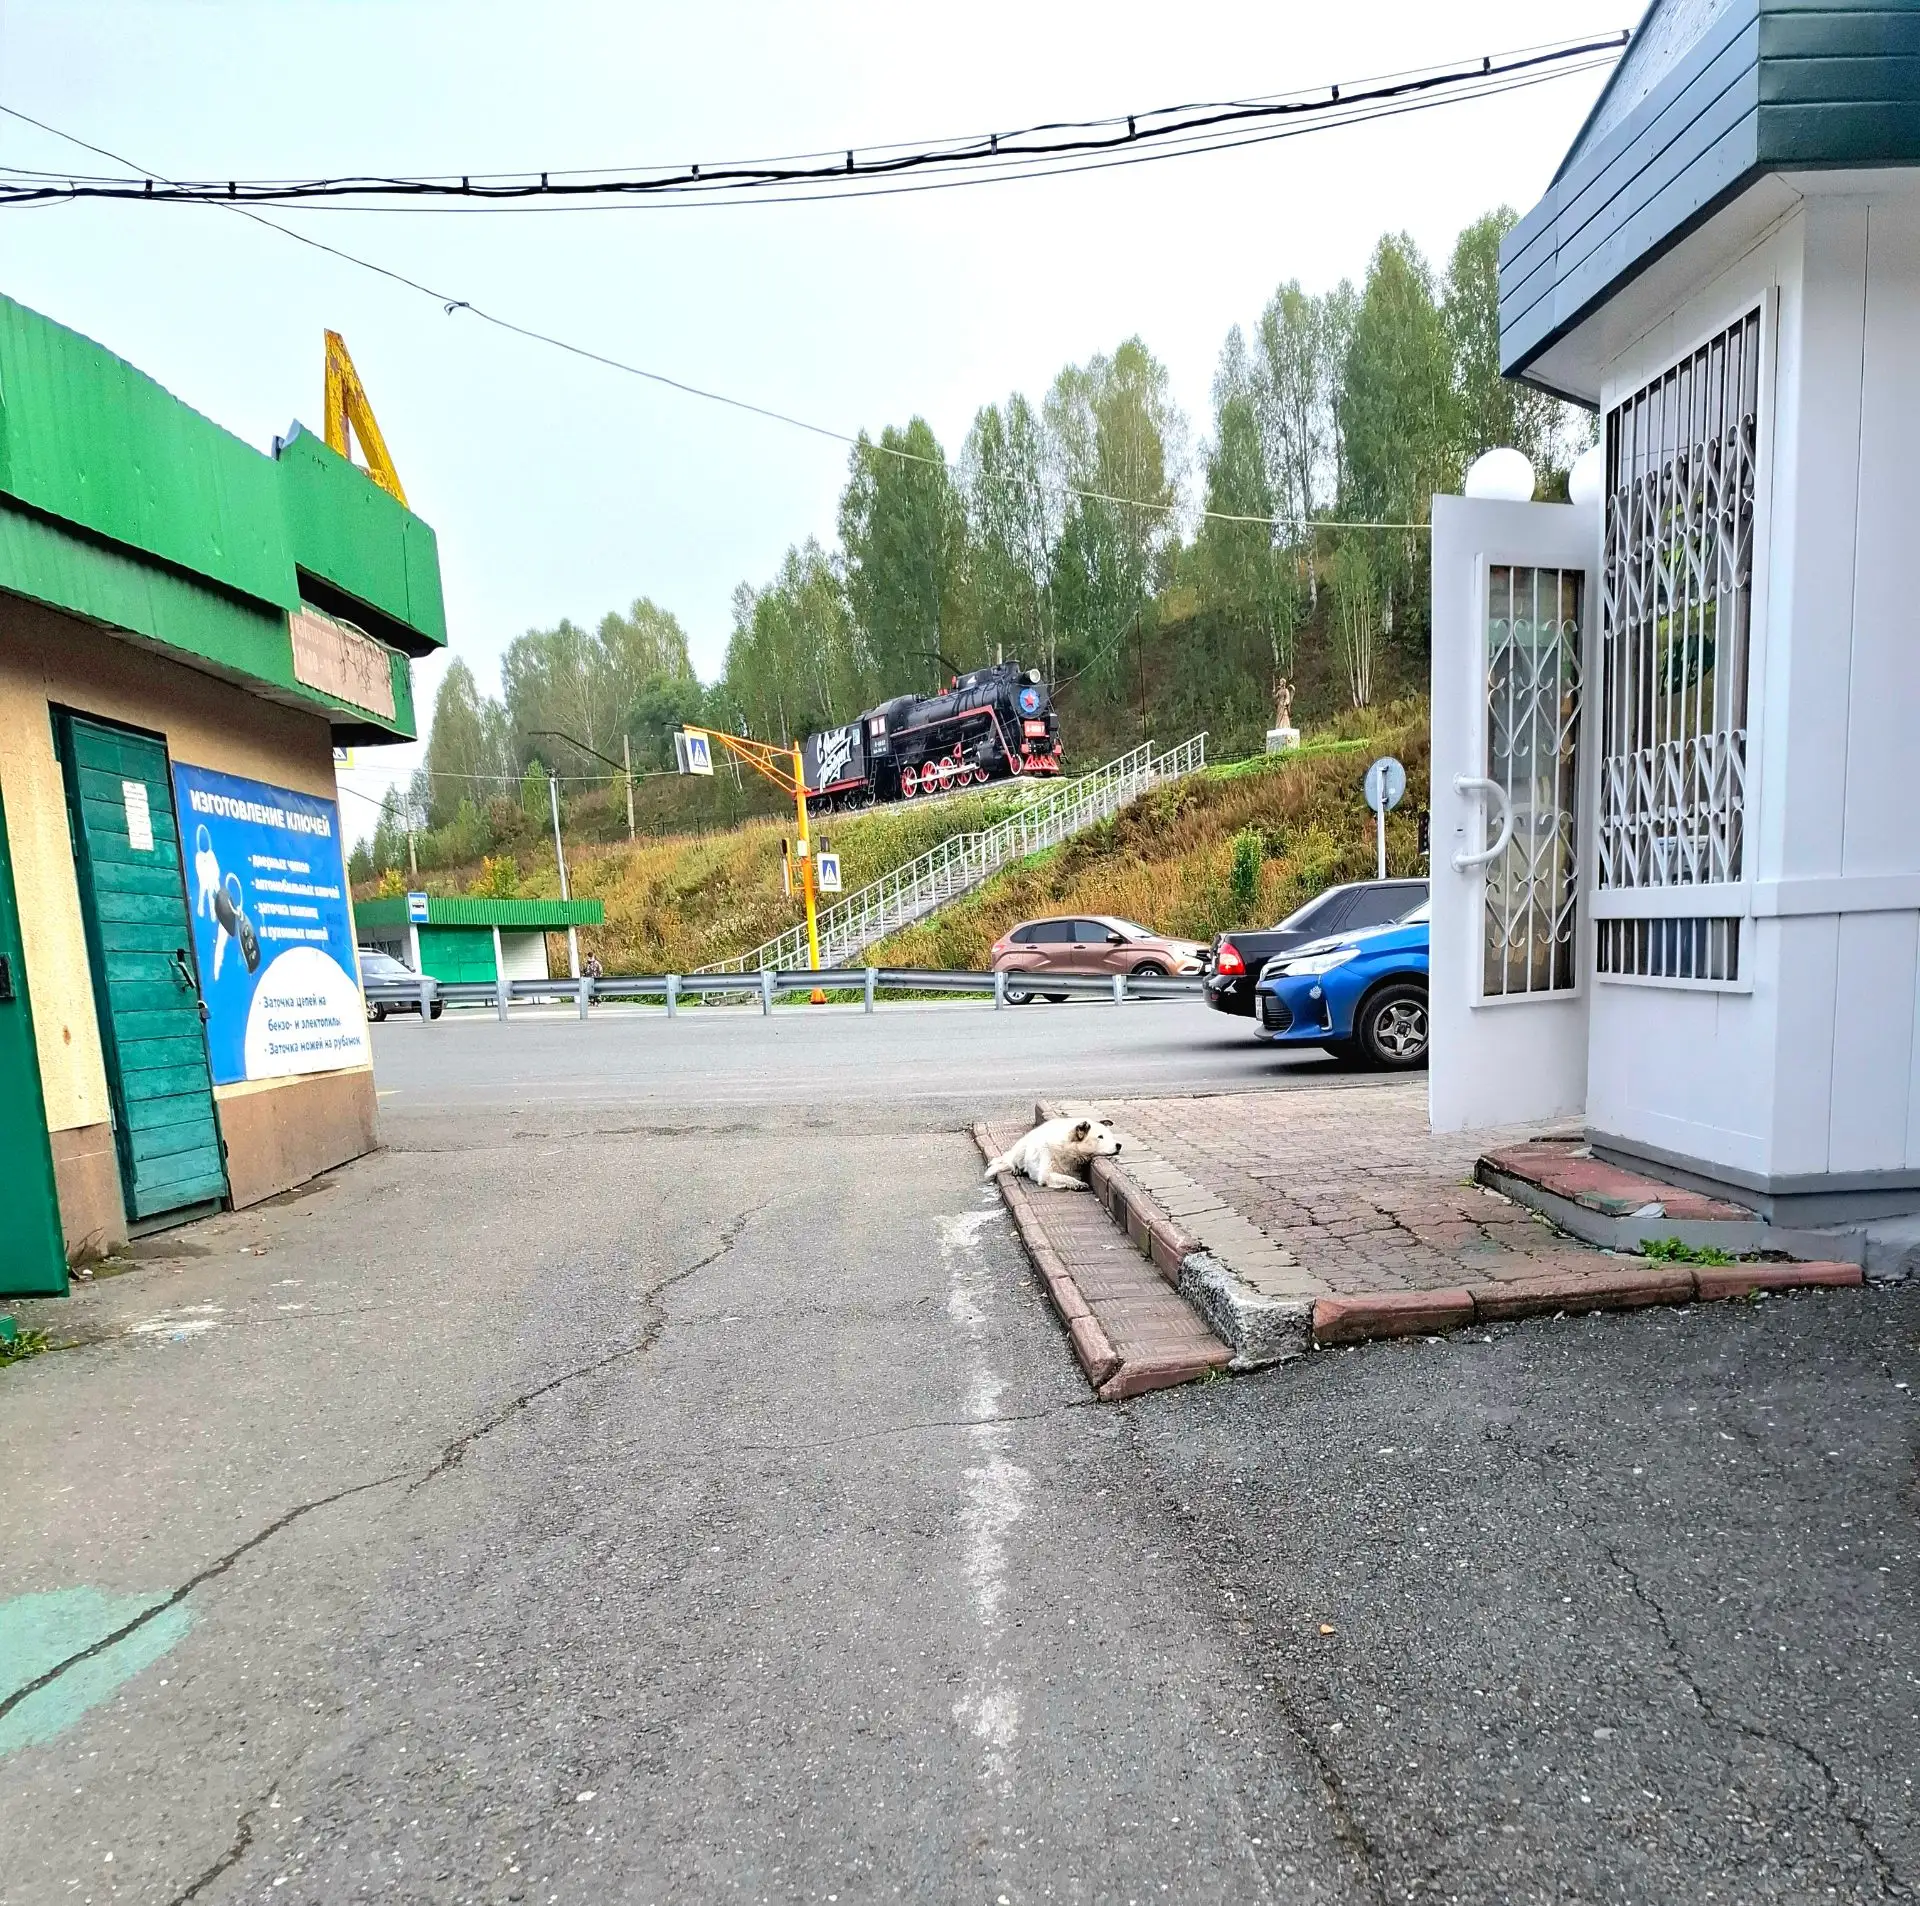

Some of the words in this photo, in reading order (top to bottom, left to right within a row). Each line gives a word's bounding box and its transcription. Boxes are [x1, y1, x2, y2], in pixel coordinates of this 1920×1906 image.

[190, 789, 286, 829] ИЗГОТОВЛЕНИЕ
[286, 810, 332, 837] КЛЮЧЕЙ
[263, 996, 295, 1008] Заточка
[296, 993, 318, 1008] цепей
[318, 996, 327, 1006] на
[294, 1020, 300, 1029] и
[268, 1042, 299, 1055] Заточка
[300, 1037, 324, 1051] ножей
[324, 1040, 332, 1049] на
[333, 1035, 361, 1051] рубанок
